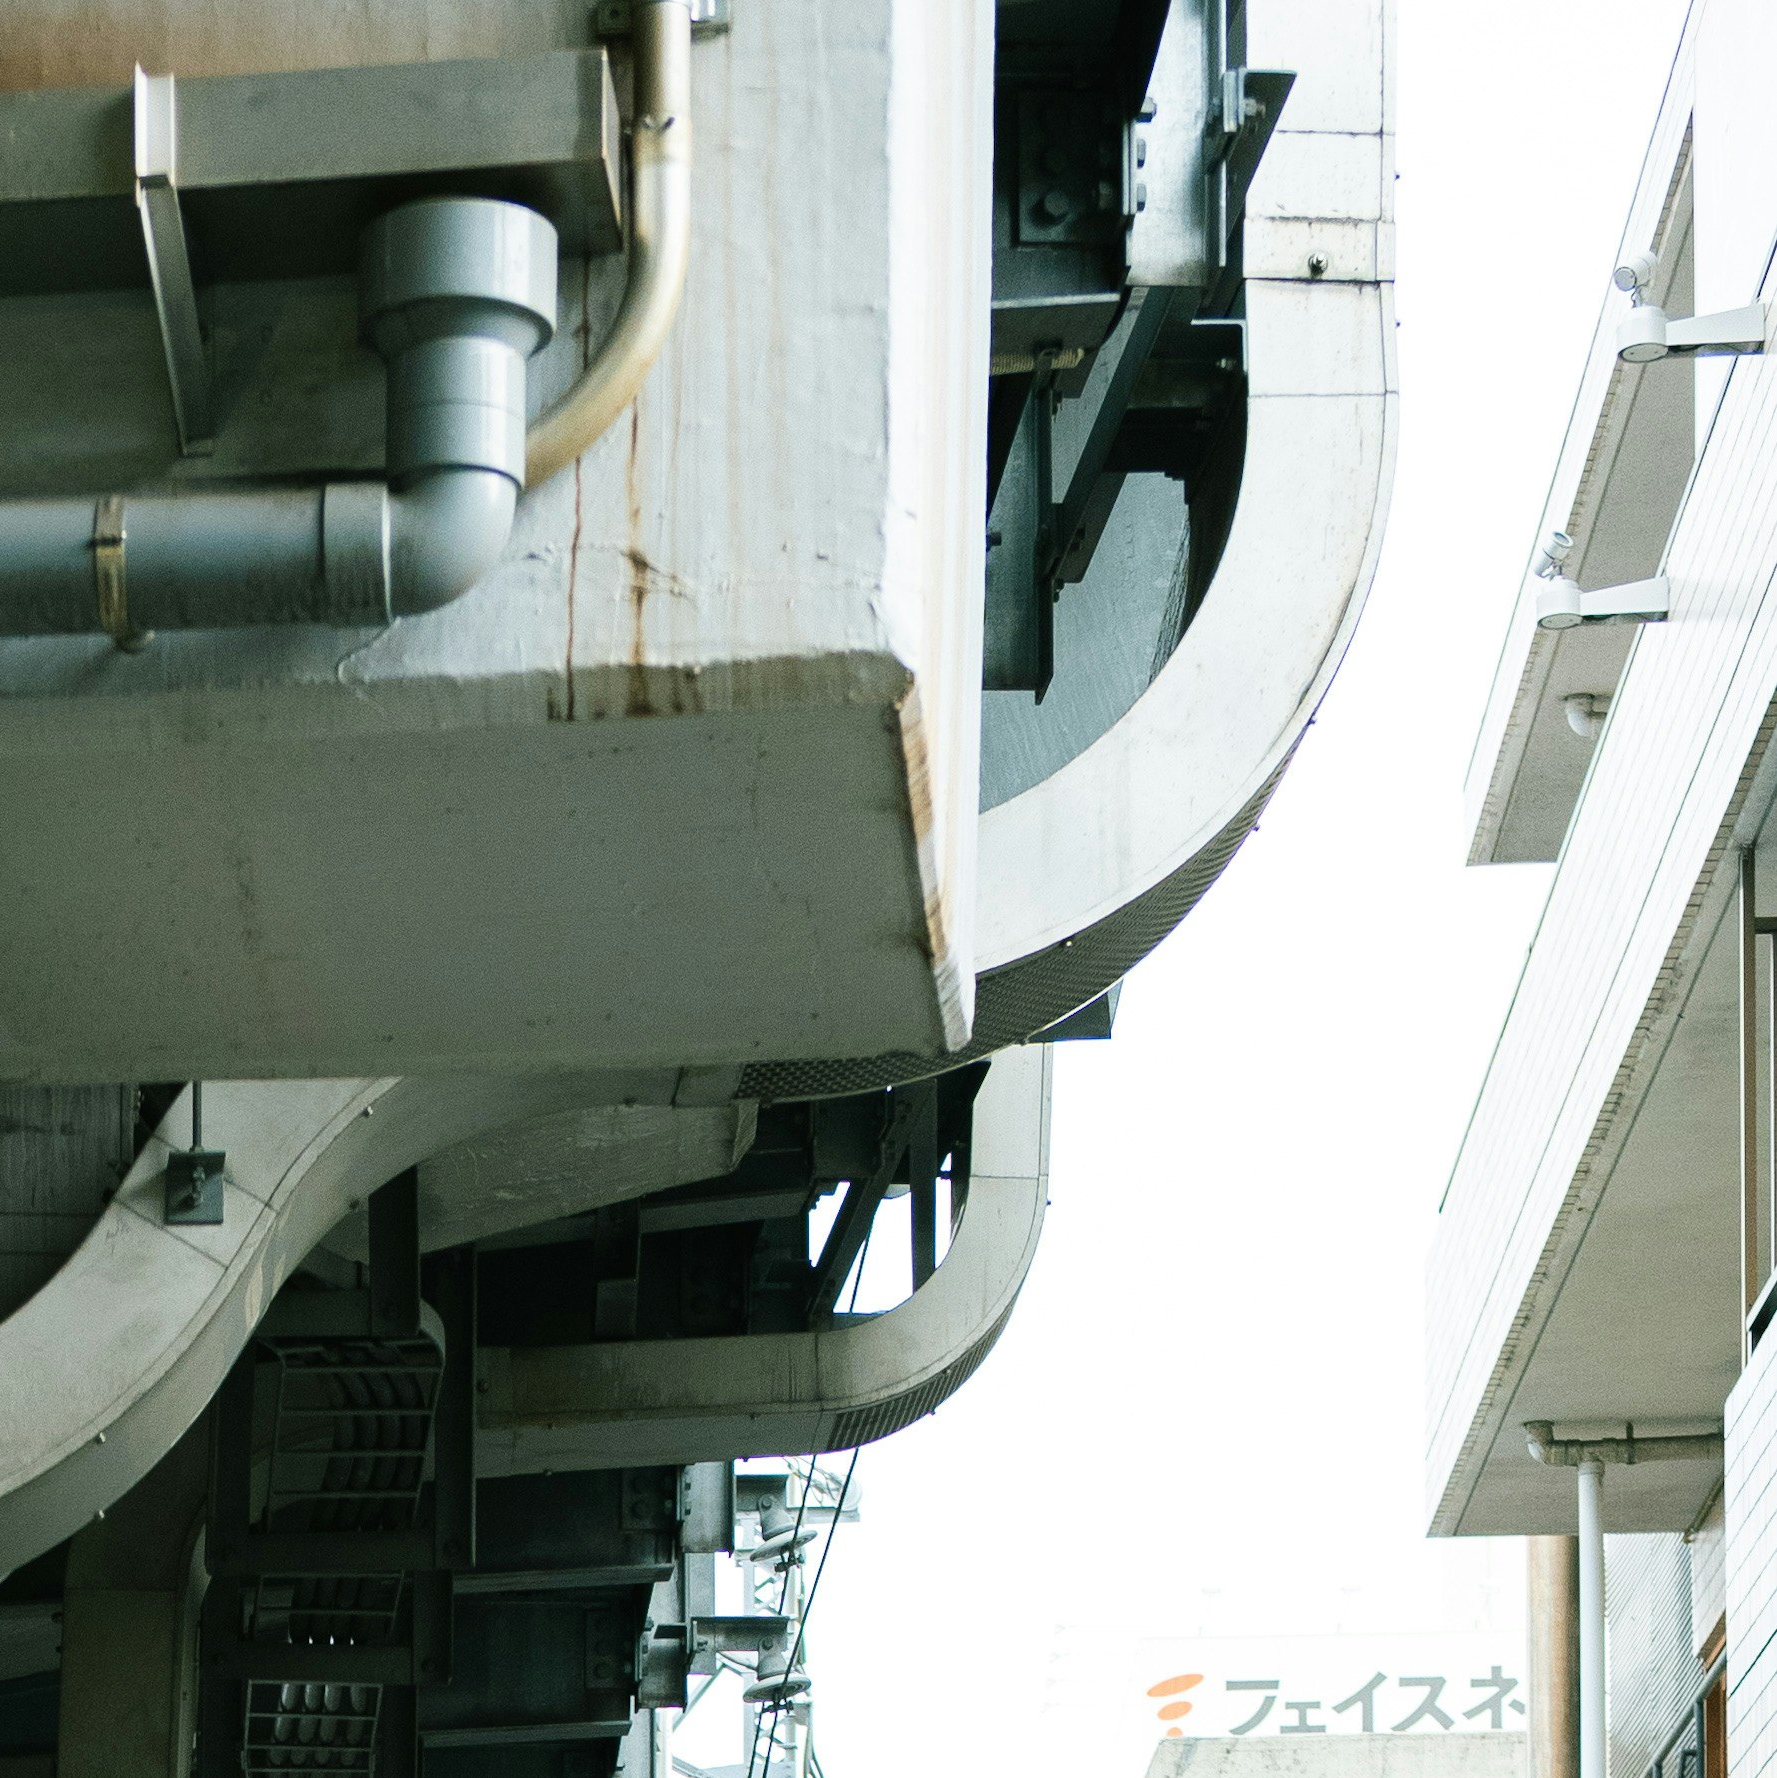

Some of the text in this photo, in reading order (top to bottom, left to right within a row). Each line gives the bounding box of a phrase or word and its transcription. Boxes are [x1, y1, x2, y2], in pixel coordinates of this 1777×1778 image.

[1224, 1665, 1526, 1735] フェイスネ
